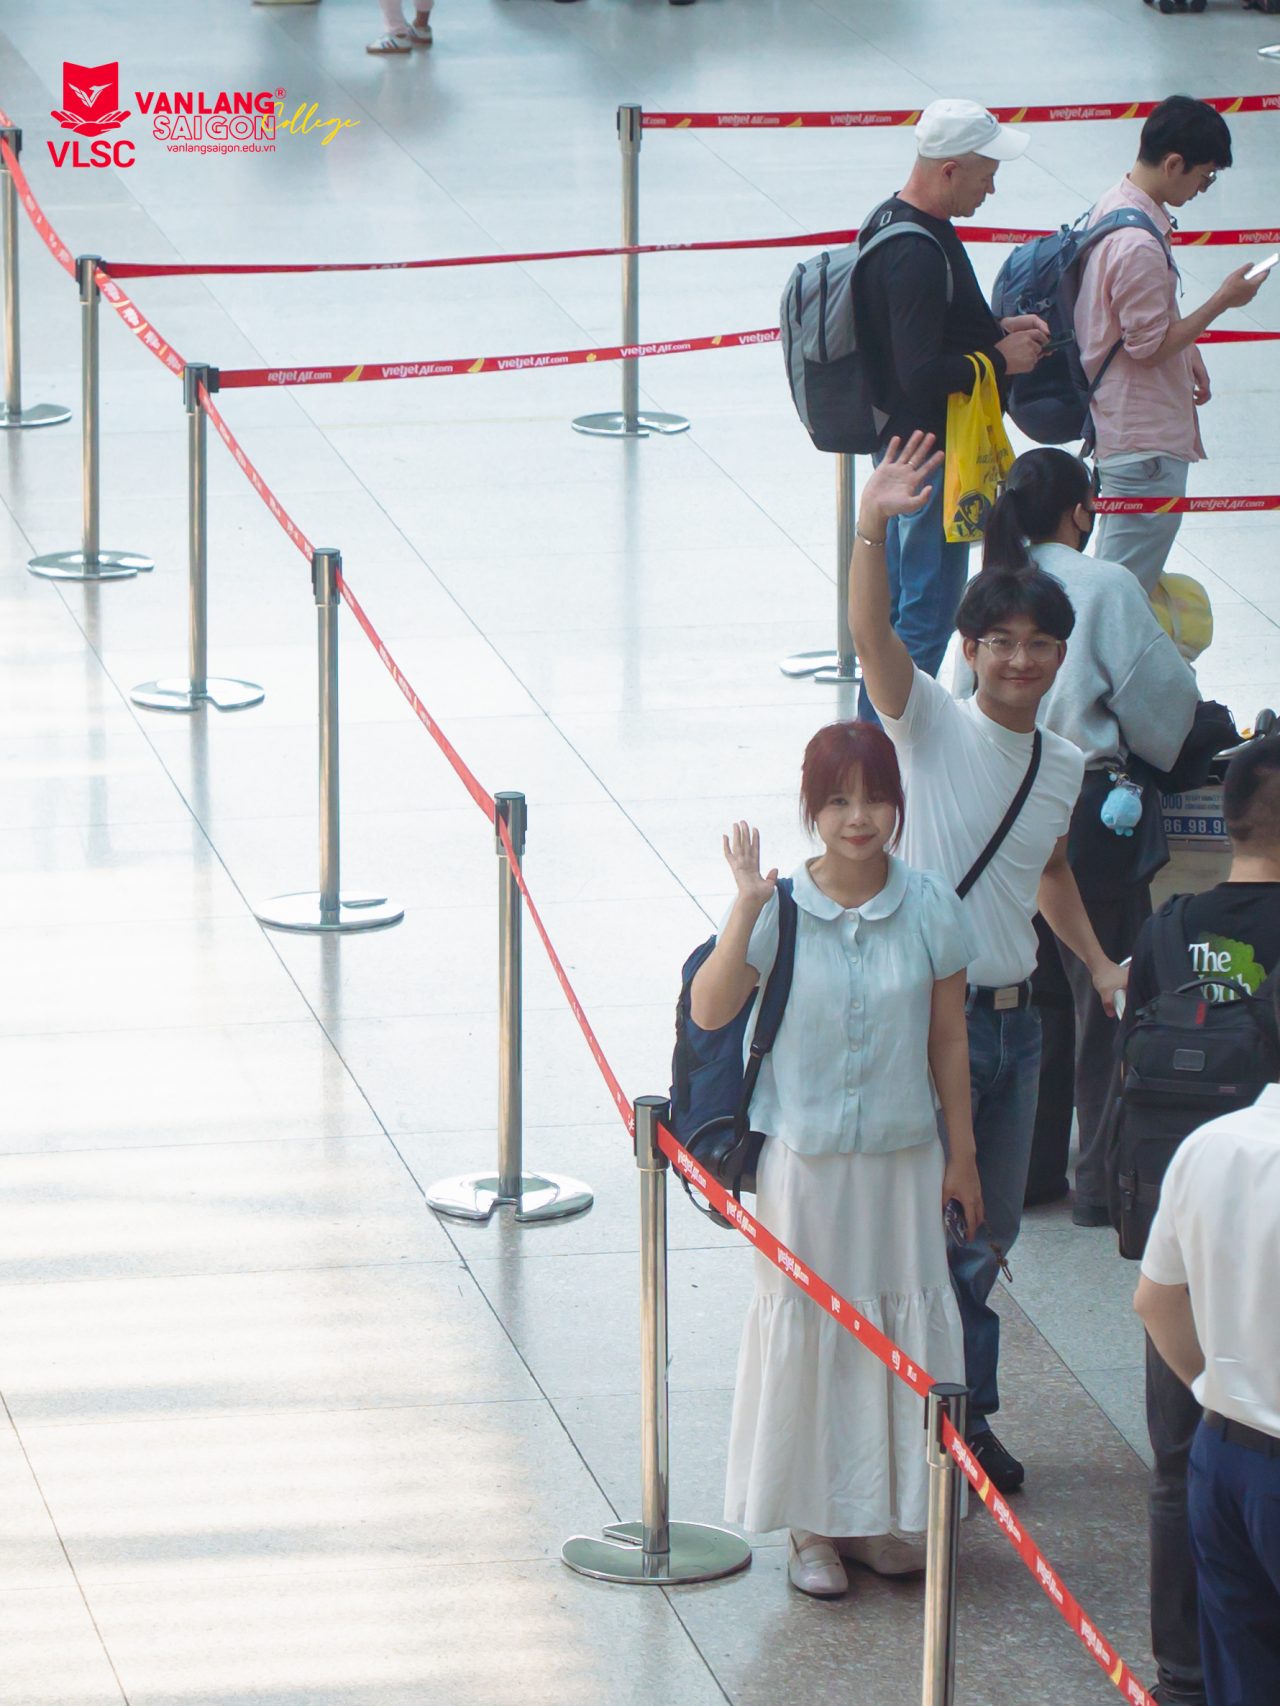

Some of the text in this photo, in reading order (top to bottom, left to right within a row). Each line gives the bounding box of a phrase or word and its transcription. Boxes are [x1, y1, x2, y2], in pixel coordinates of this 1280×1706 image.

[381, 364, 454, 378] VietjetAir.com
[497, 355, 569, 370] VietjetAir.com
[620, 343, 691, 358] VietjetAir.com
[1188, 942, 1231, 972] The
[1198, 973, 1252, 1003] orth
